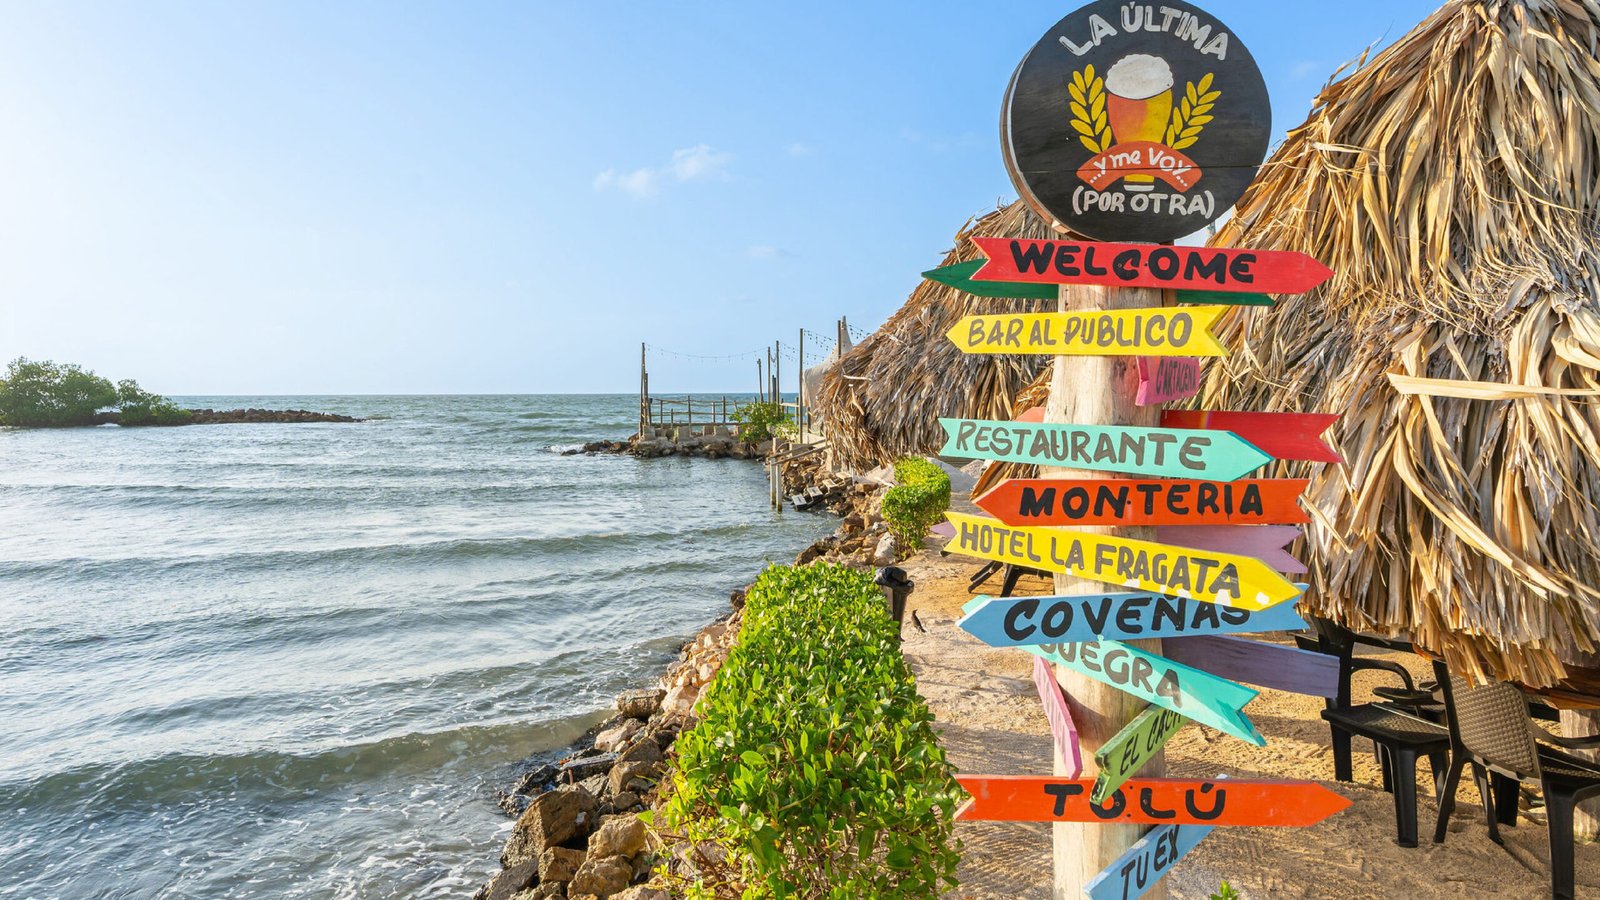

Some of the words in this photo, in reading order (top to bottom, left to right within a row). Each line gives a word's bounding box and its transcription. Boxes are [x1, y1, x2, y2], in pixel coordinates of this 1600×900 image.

[1059, 14, 1118, 56] LA
[1121, 2, 1229, 61] ÚLTIMA
[1109, 150, 1141, 168] me
[1072, 185, 1124, 215] (POR
[1130, 190, 1215, 219] OTRA)
[1010, 240, 1257, 284] WELCOME
[968, 318, 1024, 348] BAR
[1029, 319, 1057, 346] AL
[1064, 312, 1193, 348] PUBLICO
[956, 421, 1212, 470] RESTAURANTE
[1019, 483, 1263, 519] MONTERIA
[960, 521, 1041, 563] HOTEL
[1050, 530, 1085, 570] LA
[1094, 543, 1241, 599] FRAGATA
[1120, 733, 1140, 776] EL
[1044, 782, 1227, 820] TOLÚ
[1121, 851, 1149, 900] TU
[1154, 824, 1180, 872] EX
